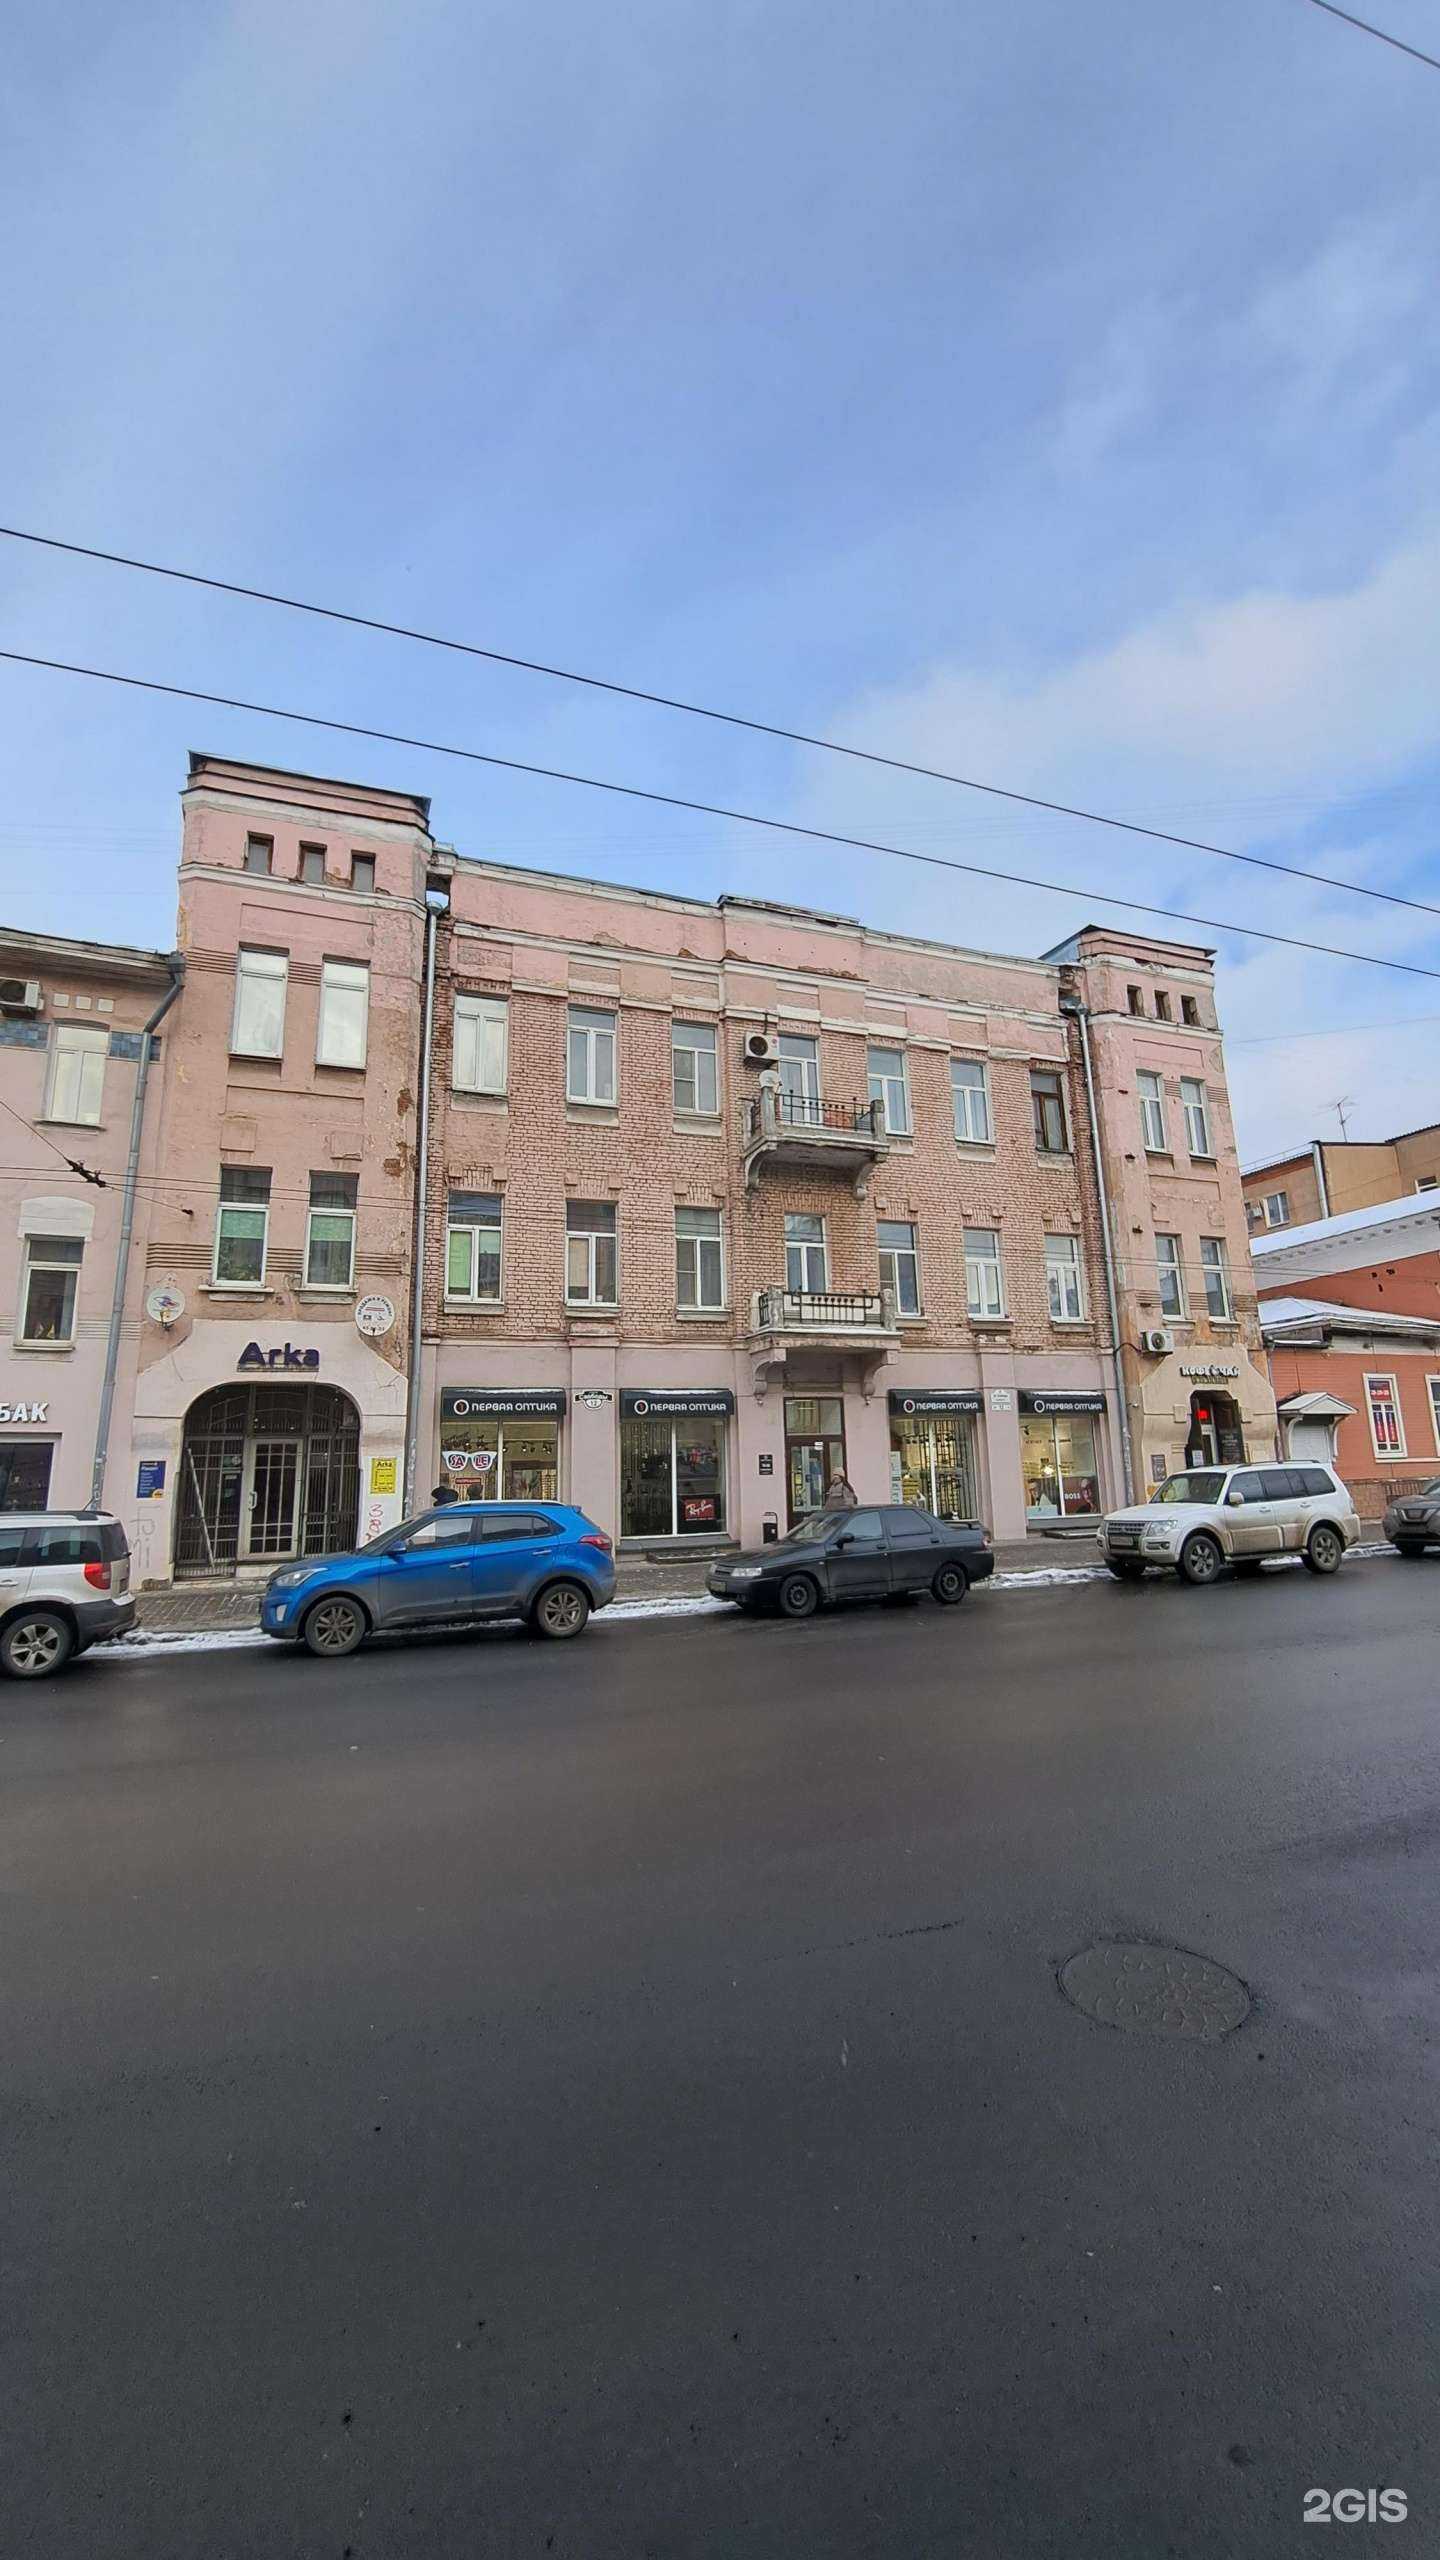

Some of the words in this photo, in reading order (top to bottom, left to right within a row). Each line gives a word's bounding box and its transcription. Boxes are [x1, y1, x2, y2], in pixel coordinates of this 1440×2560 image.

[238, 1342, 320, 1367] Arka
[472, 1403, 513, 1411] ПЕРВАЯ
[515, 1402, 558, 1411] ОПТИКА
[650, 1403, 687, 1411] ПЕРВАЯ
[689, 1403, 727, 1411] ОПТИКА
[1064, 1492, 1081, 1500] BOSS
